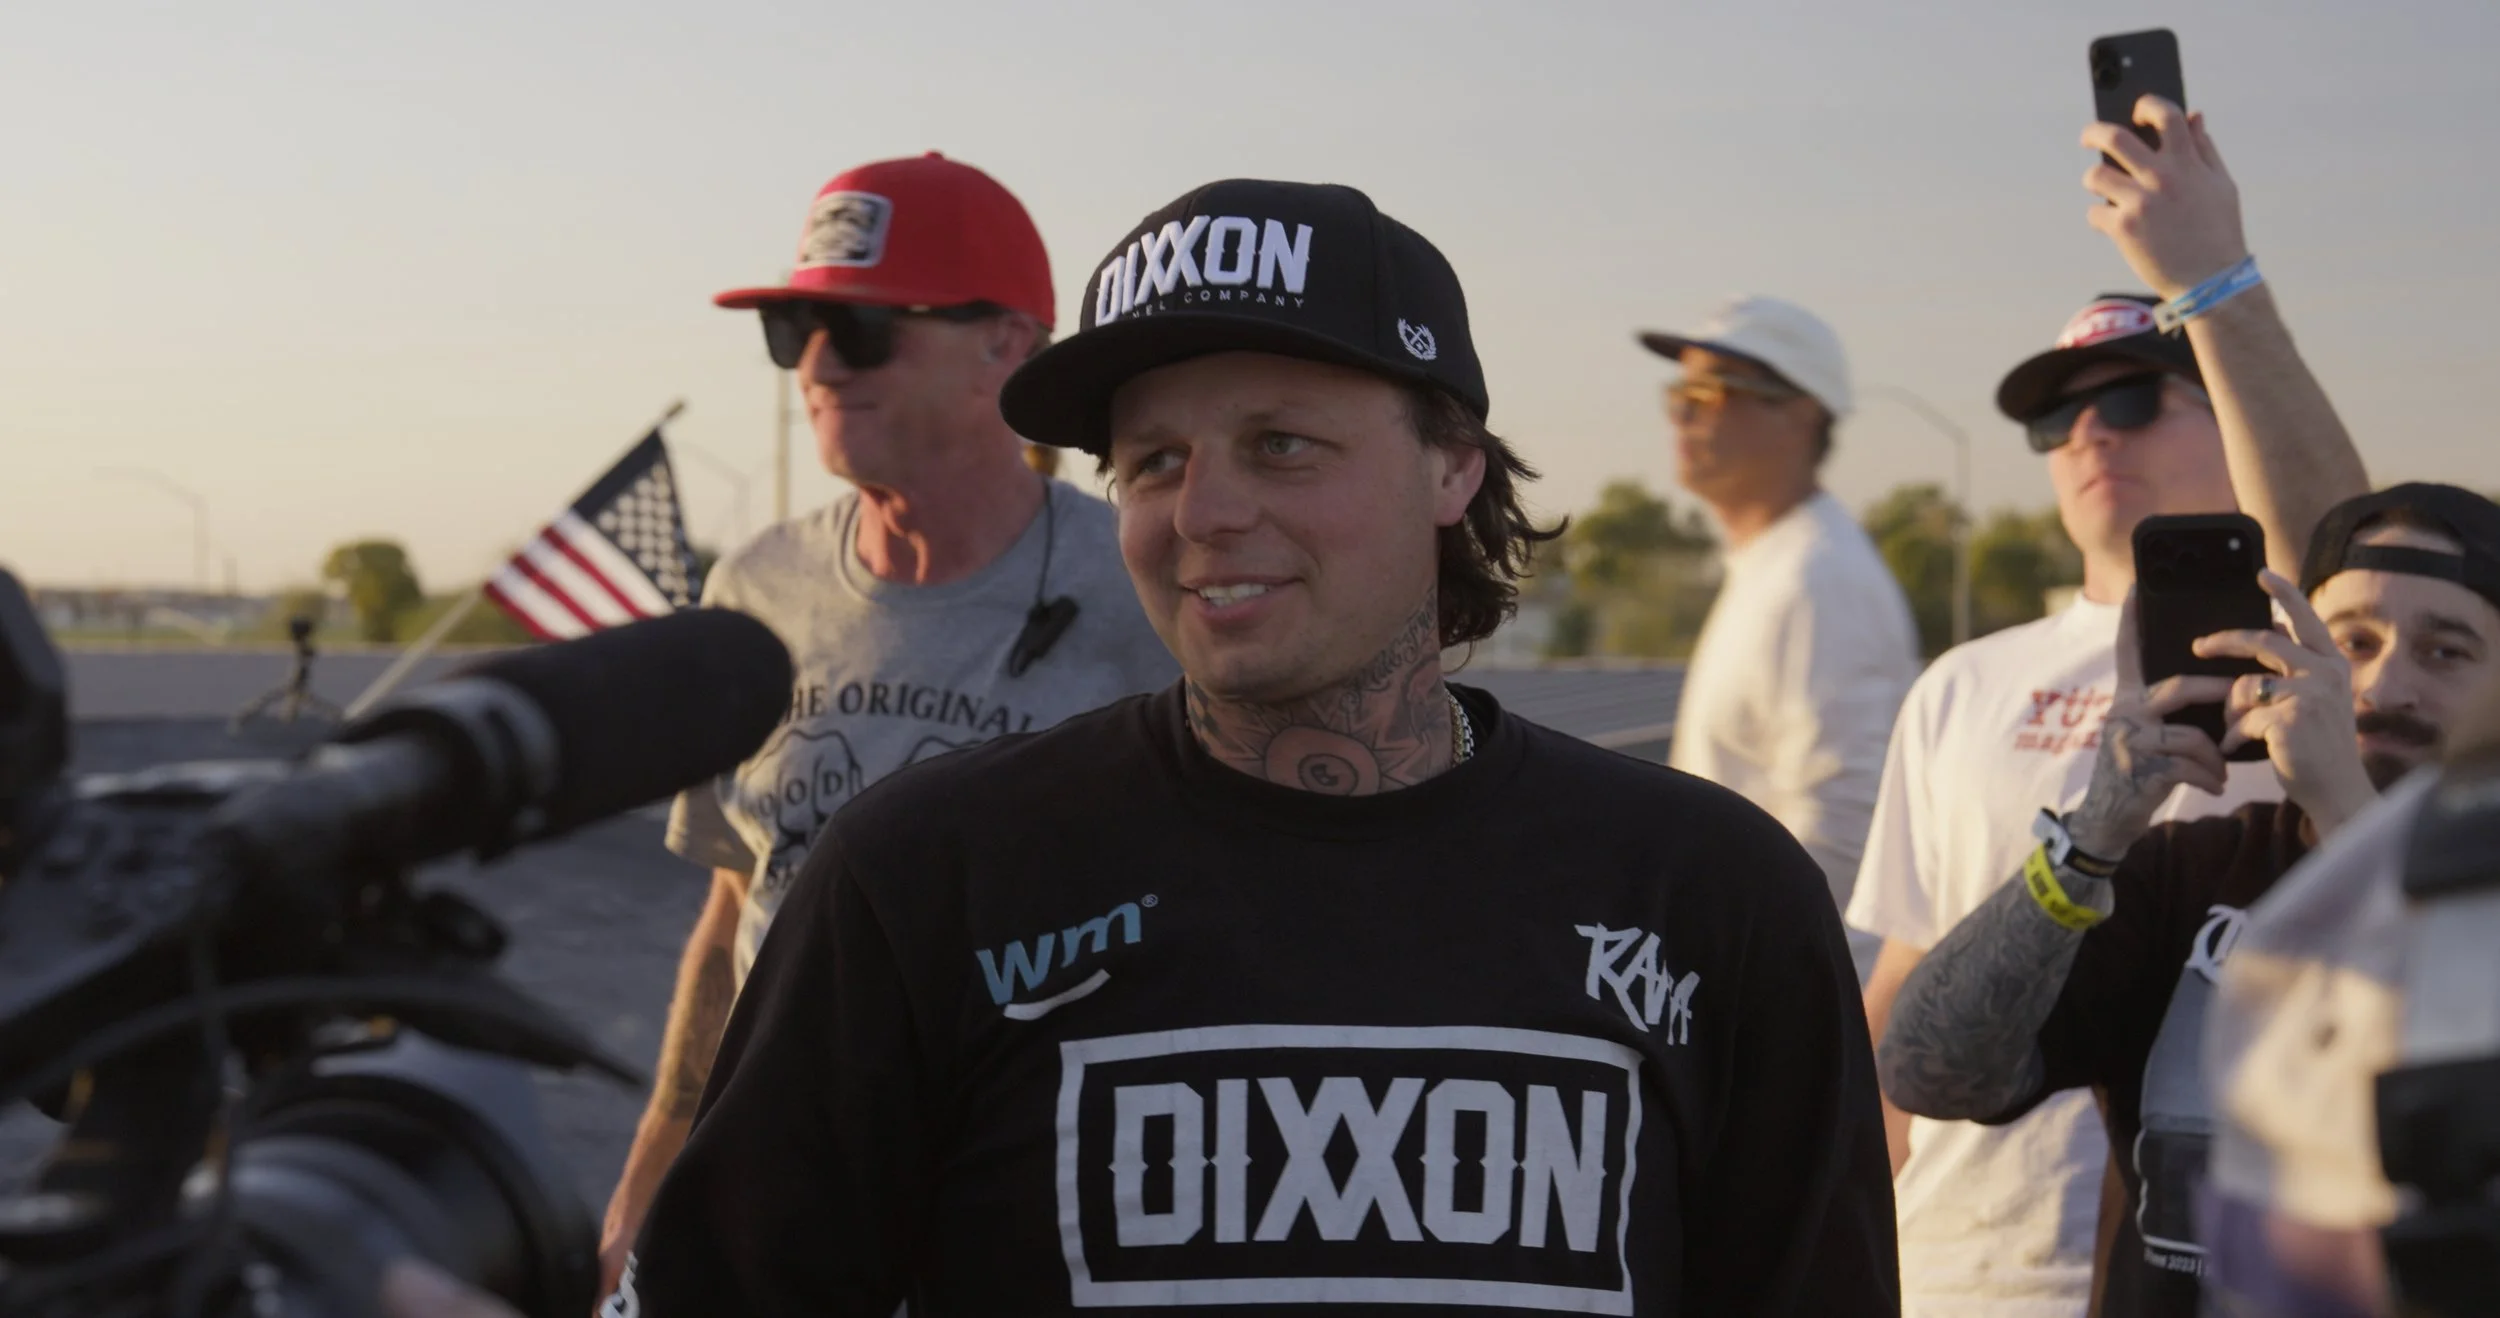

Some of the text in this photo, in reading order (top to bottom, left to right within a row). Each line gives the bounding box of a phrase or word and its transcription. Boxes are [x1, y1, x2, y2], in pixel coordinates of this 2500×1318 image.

[1096, 214, 1313, 327] DIXXON
[1183, 288, 1304, 309] COMPANY
[786, 684, 828, 723] HE
[758, 770, 843, 818] OOD
[1108, 1076, 1608, 1253] DIXXON
